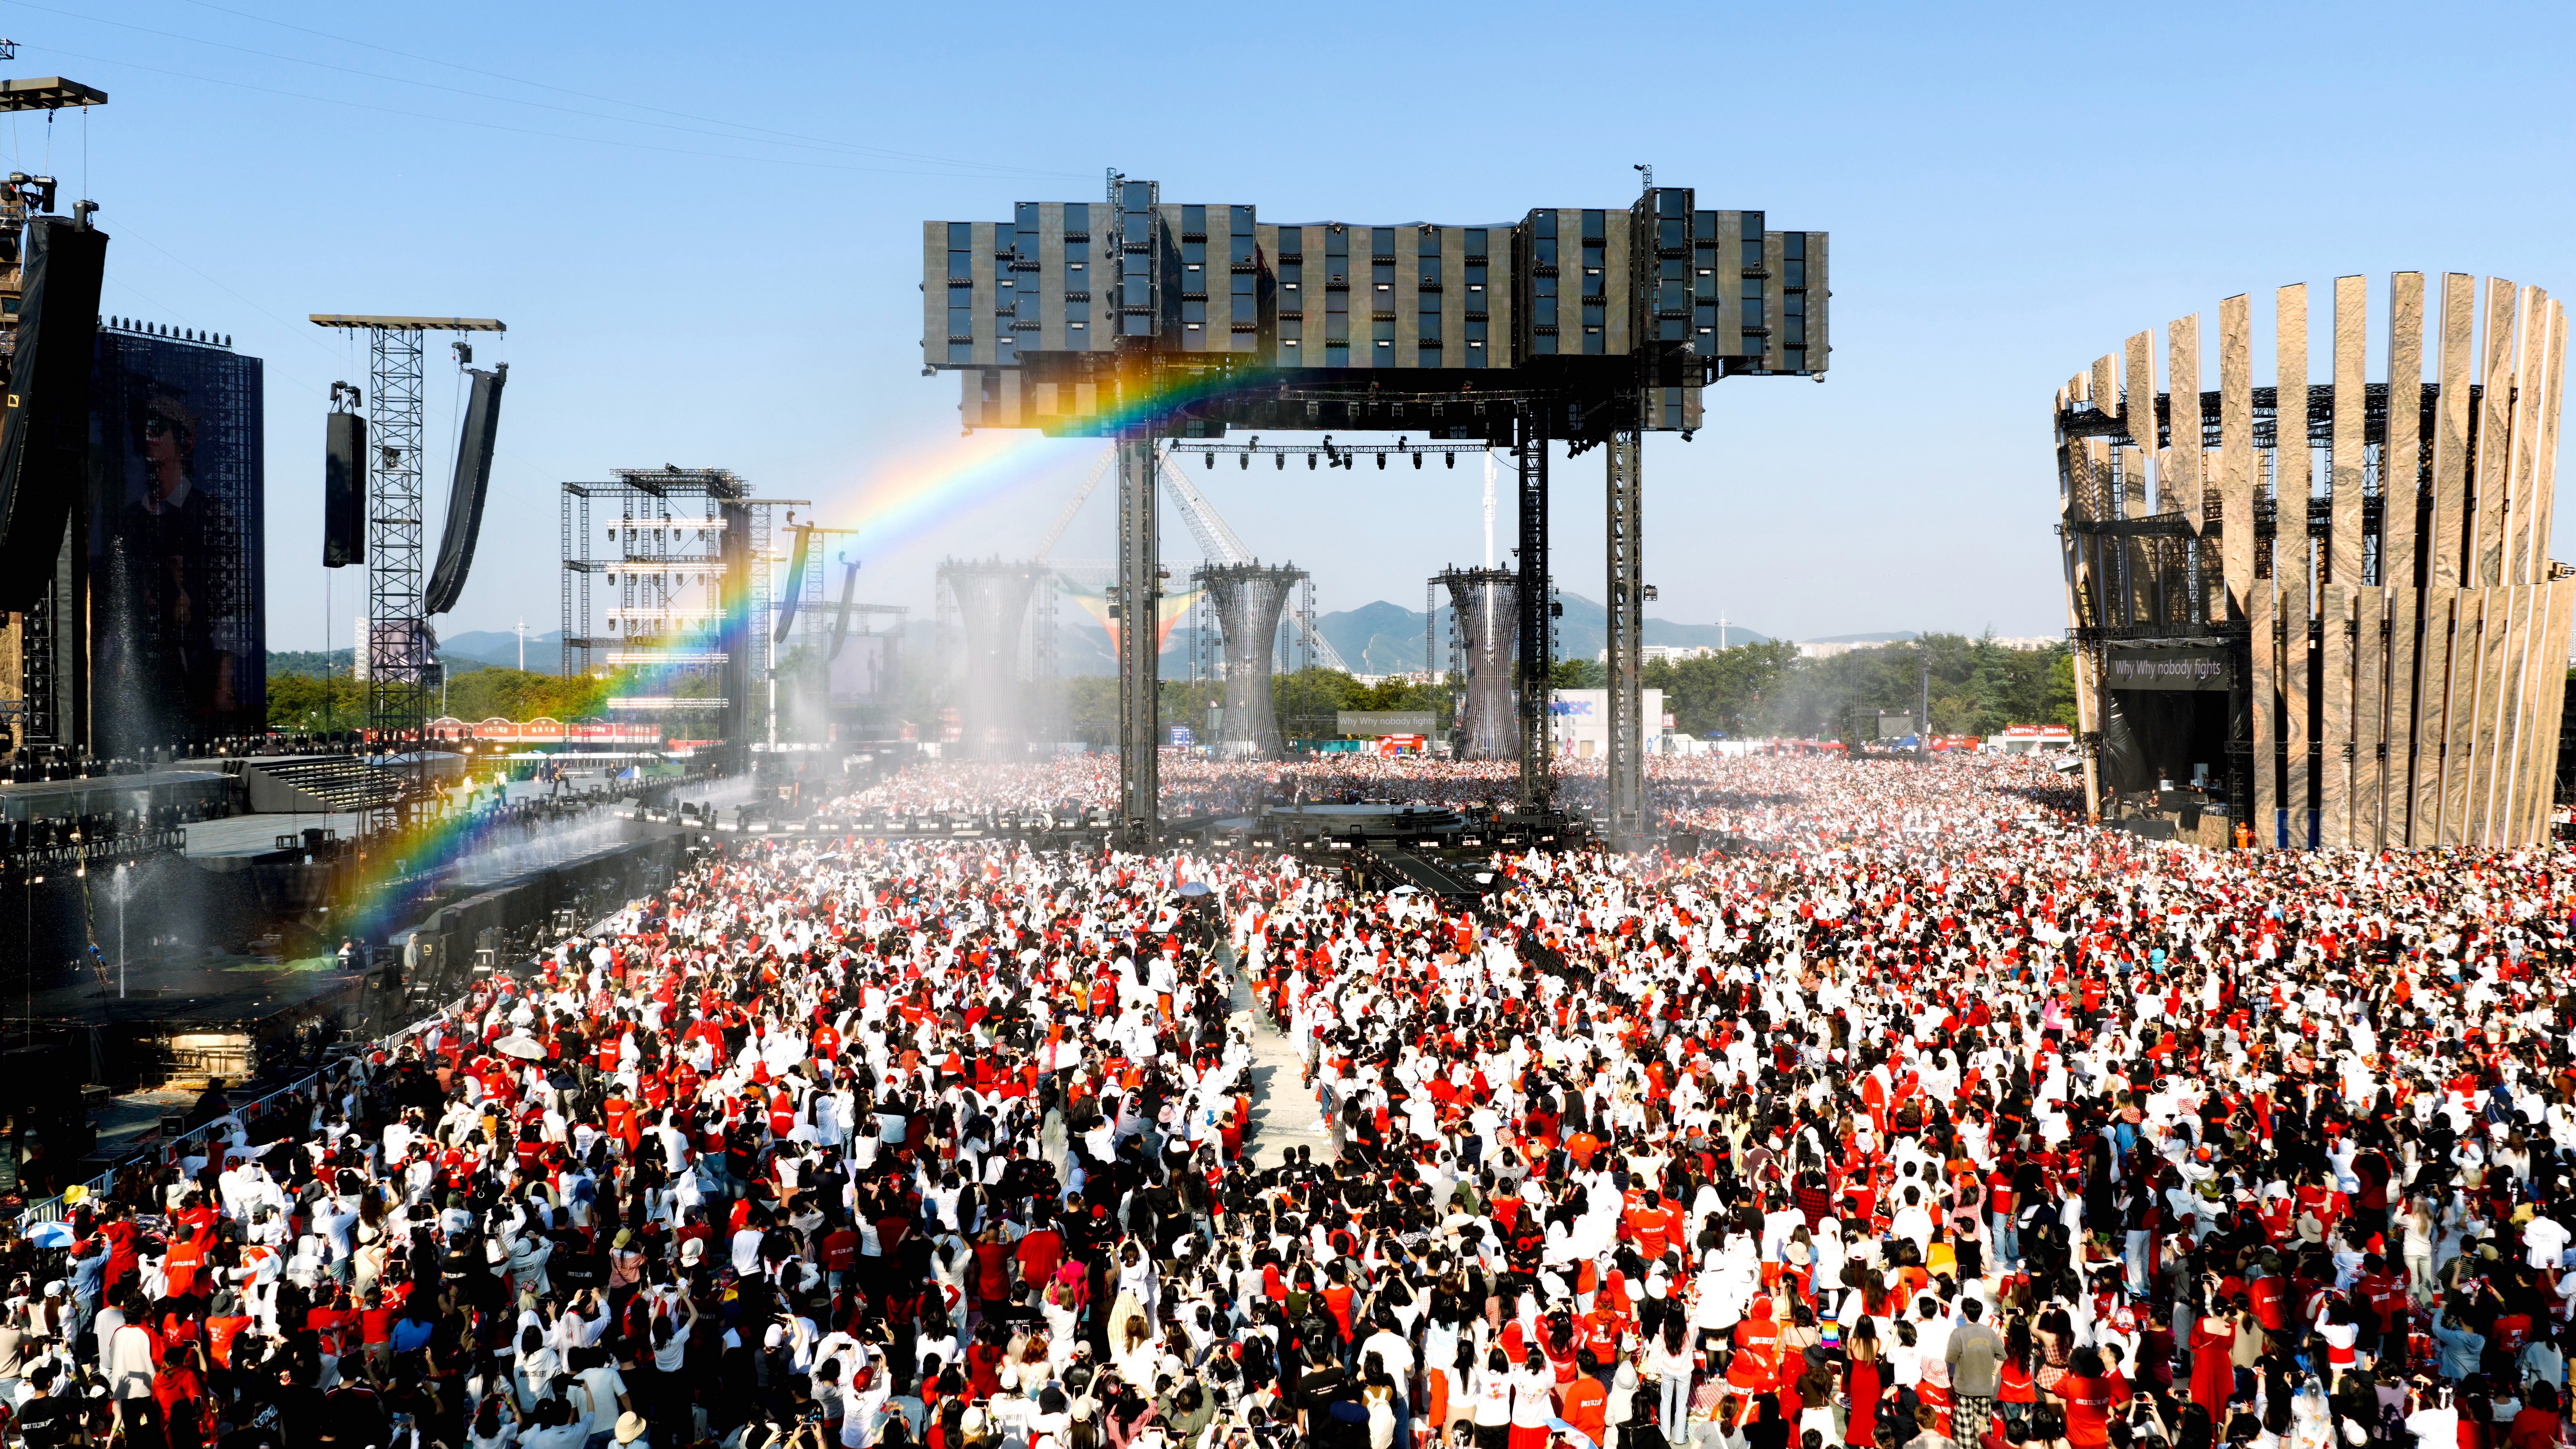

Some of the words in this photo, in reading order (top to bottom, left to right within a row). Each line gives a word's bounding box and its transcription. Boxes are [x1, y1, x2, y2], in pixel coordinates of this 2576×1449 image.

[2115, 659, 2134, 679] Why
[2137, 659, 2155, 679] Why
[2158, 659, 2192, 679] nobody
[2195, 659, 2221, 680] fights
[1339, 717, 1357, 727] Why
[1359, 717, 1378, 727] Why
[1380, 717, 1410, 727] nobody
[1413, 717, 1435, 727] fights
[837, 723, 849, 734] Why
[851, 723, 863, 734] Why
[865, 723, 884, 733] nobody
[529, 1369, 548, 1379] CONCERT
